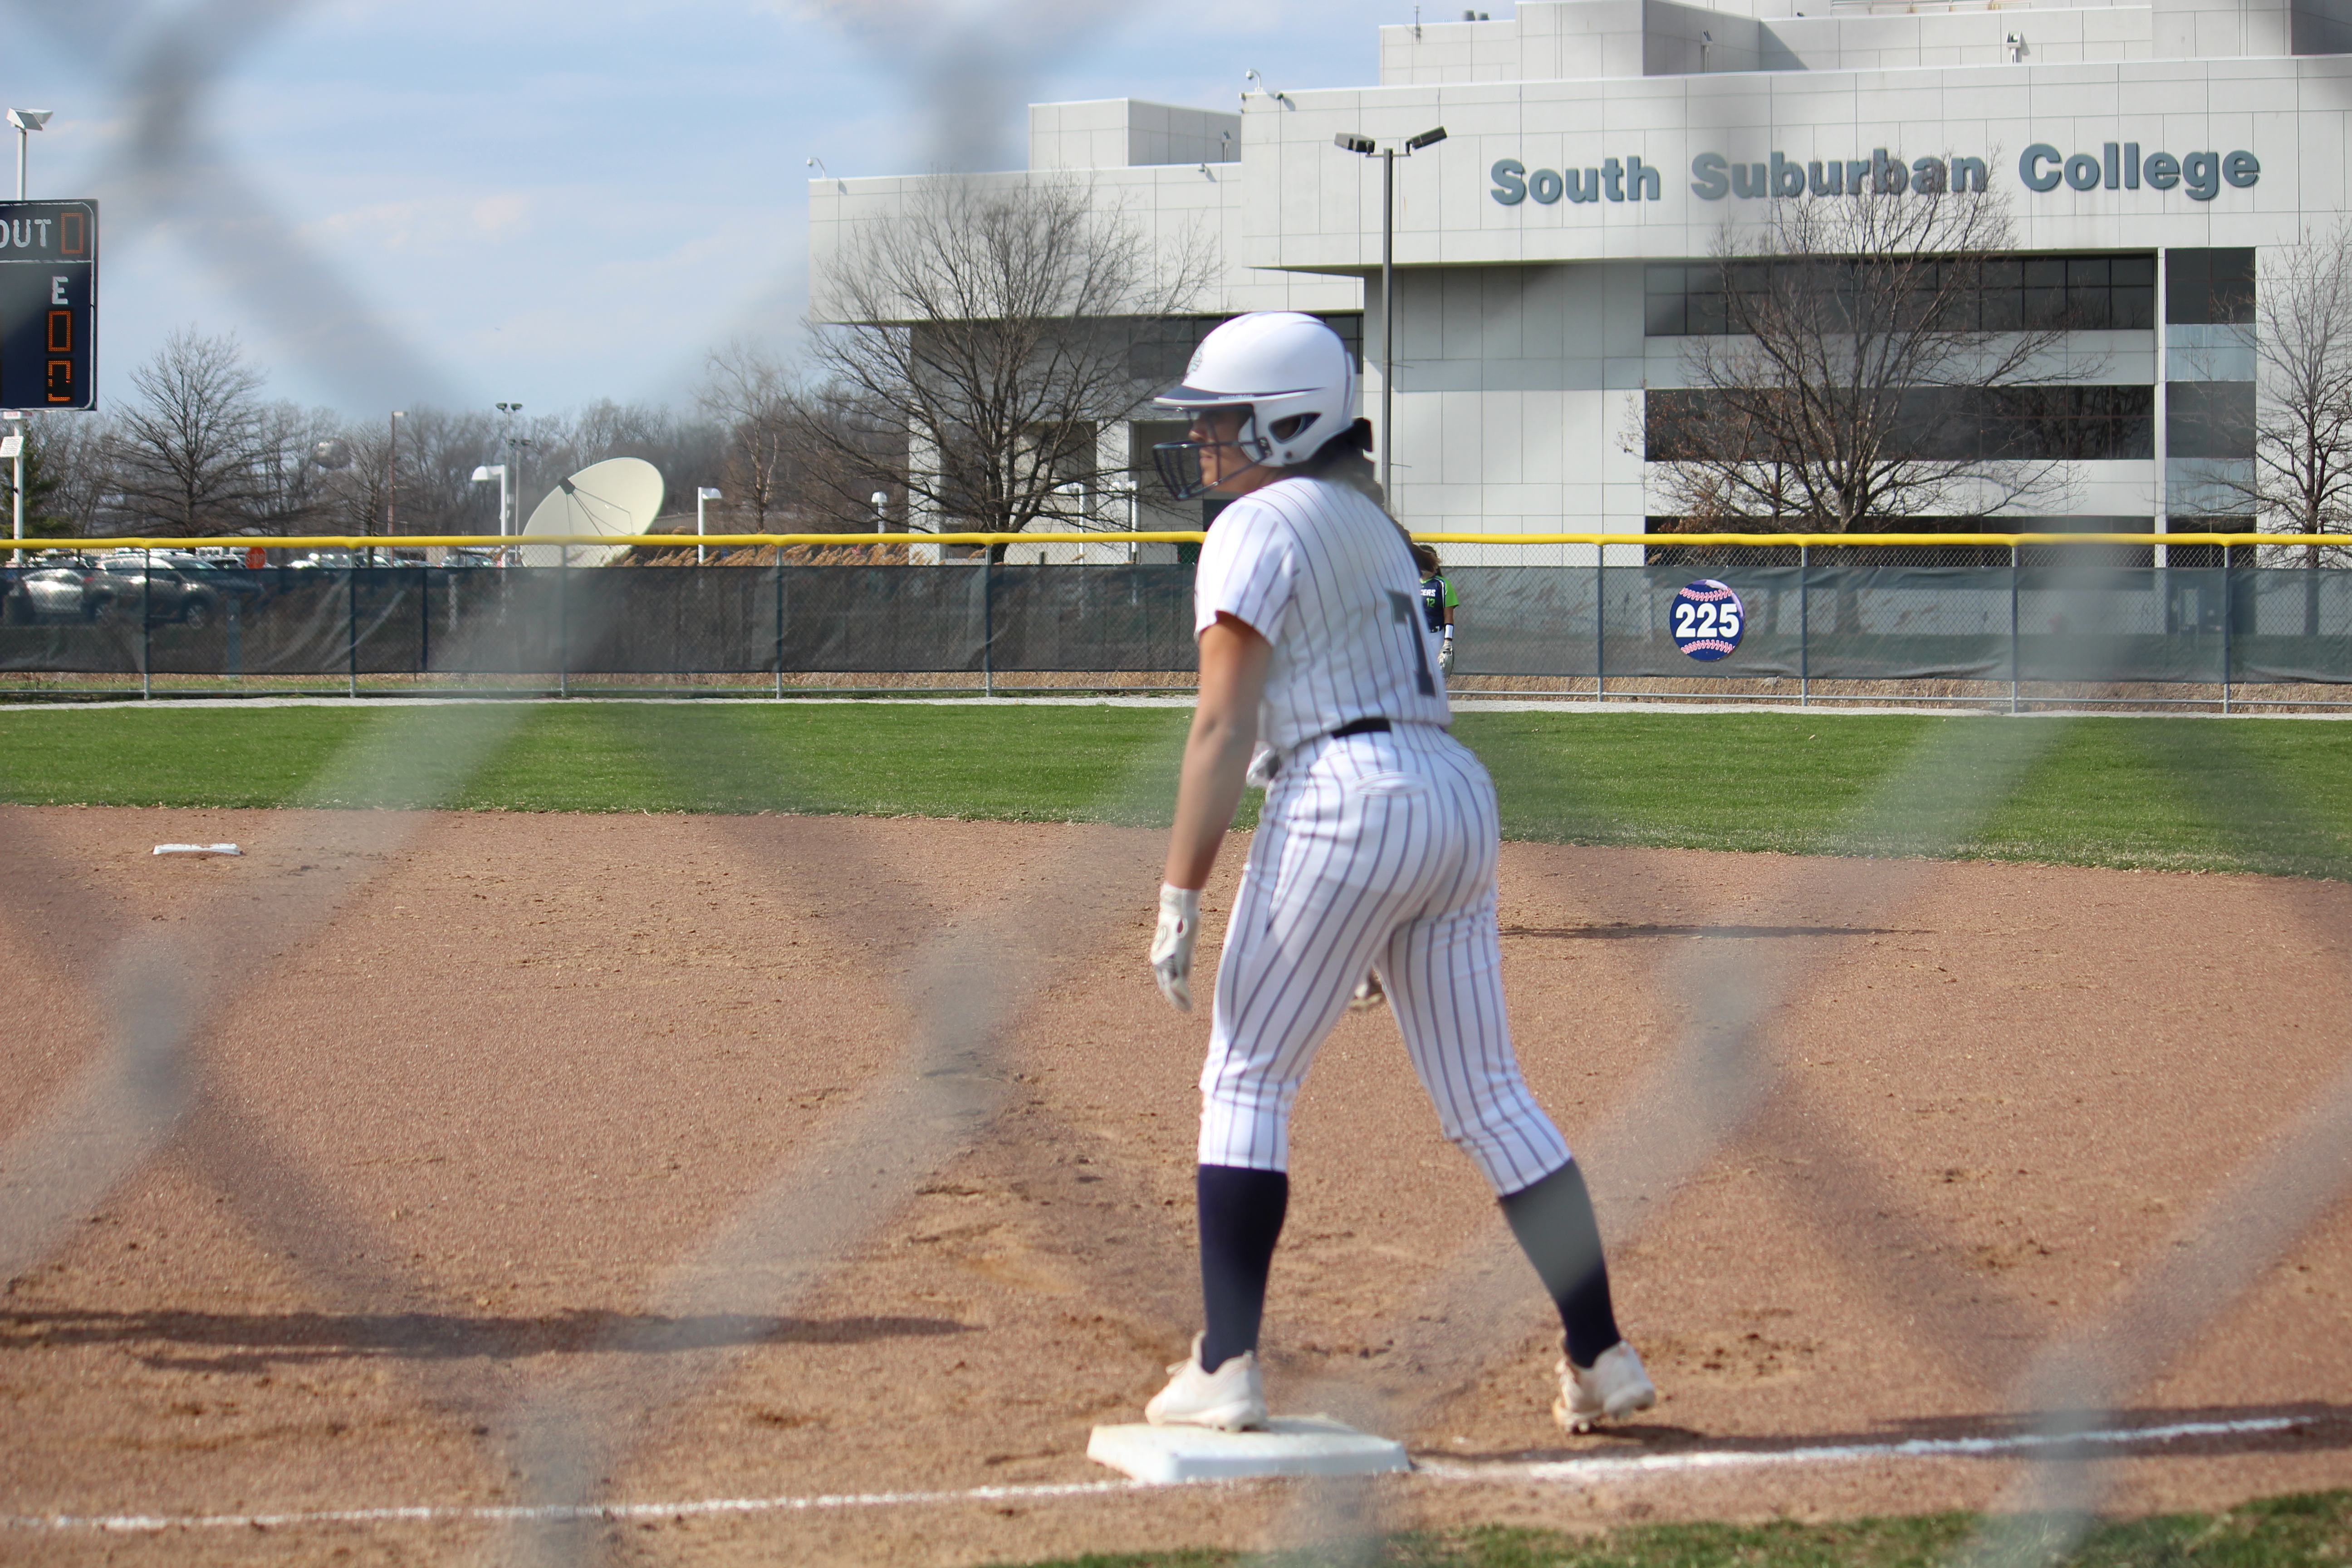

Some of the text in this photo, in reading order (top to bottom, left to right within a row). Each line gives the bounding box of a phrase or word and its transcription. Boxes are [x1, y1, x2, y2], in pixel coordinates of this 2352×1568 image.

[1490, 142, 2260, 205] South Suburban College
[52, 276, 69, 304] E
[49, 311, 70, 351] 0
[246, 554, 265, 564] STOP
[1426, 598, 1435, 608] 12
[1676, 603, 1740, 638] 225
